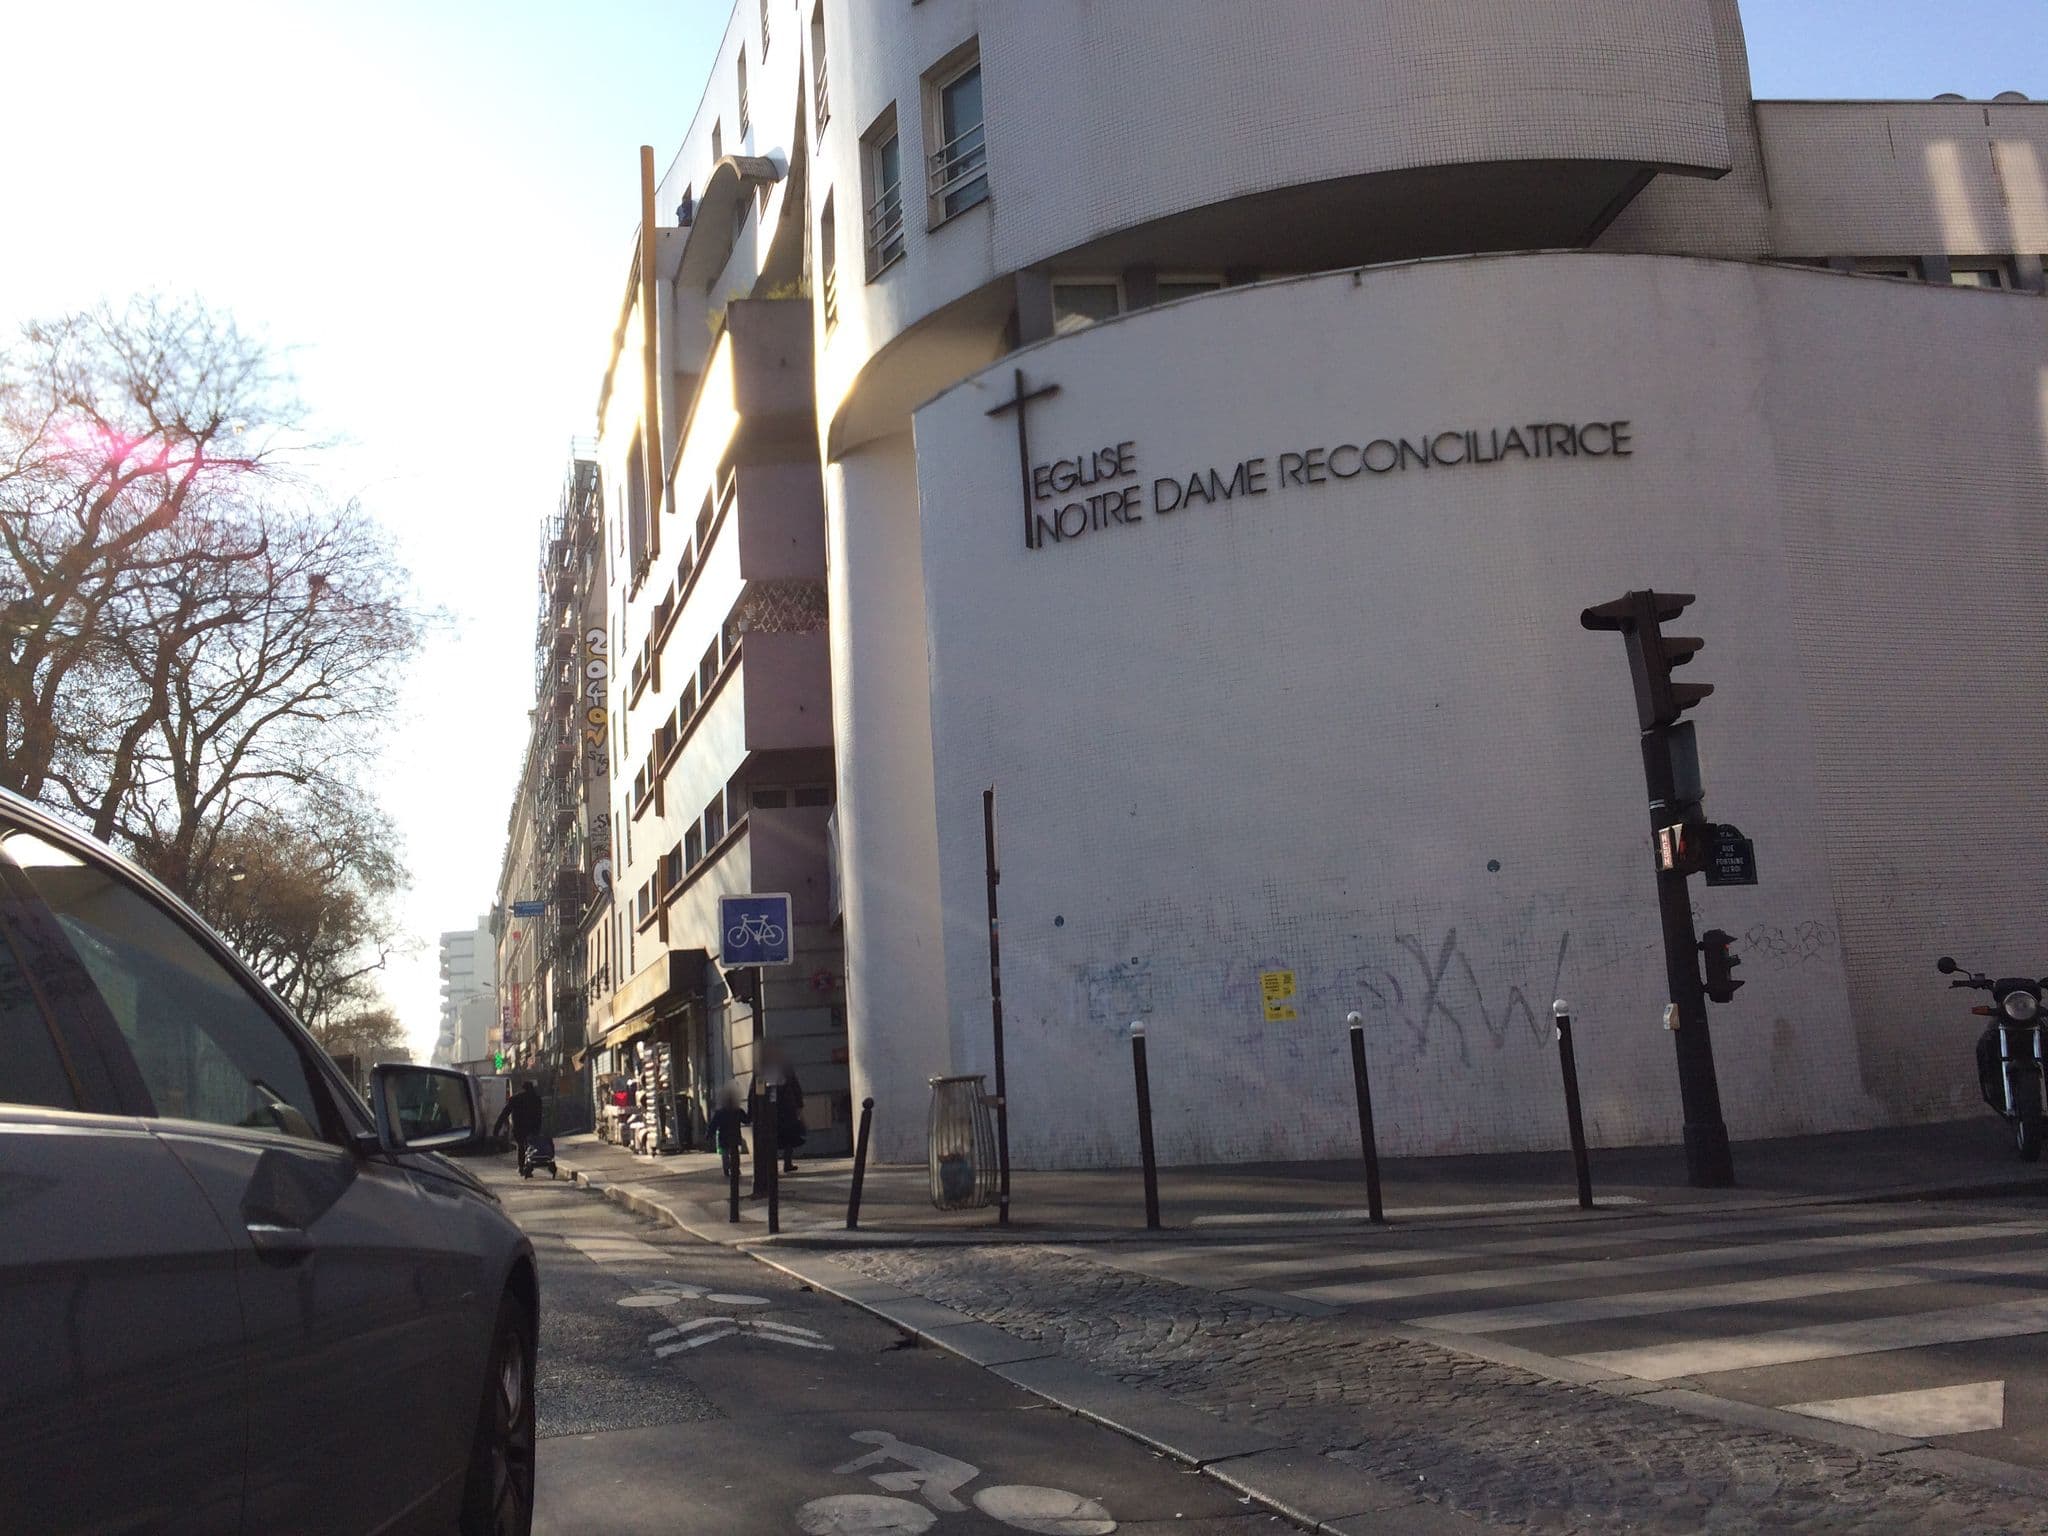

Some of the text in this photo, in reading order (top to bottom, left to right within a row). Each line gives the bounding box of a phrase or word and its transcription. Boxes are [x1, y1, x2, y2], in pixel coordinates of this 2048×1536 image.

[1033, 440, 1137, 501] EGLISE
[1036, 421, 1634, 548] NOTRE DAME RECONCILIATRICE
